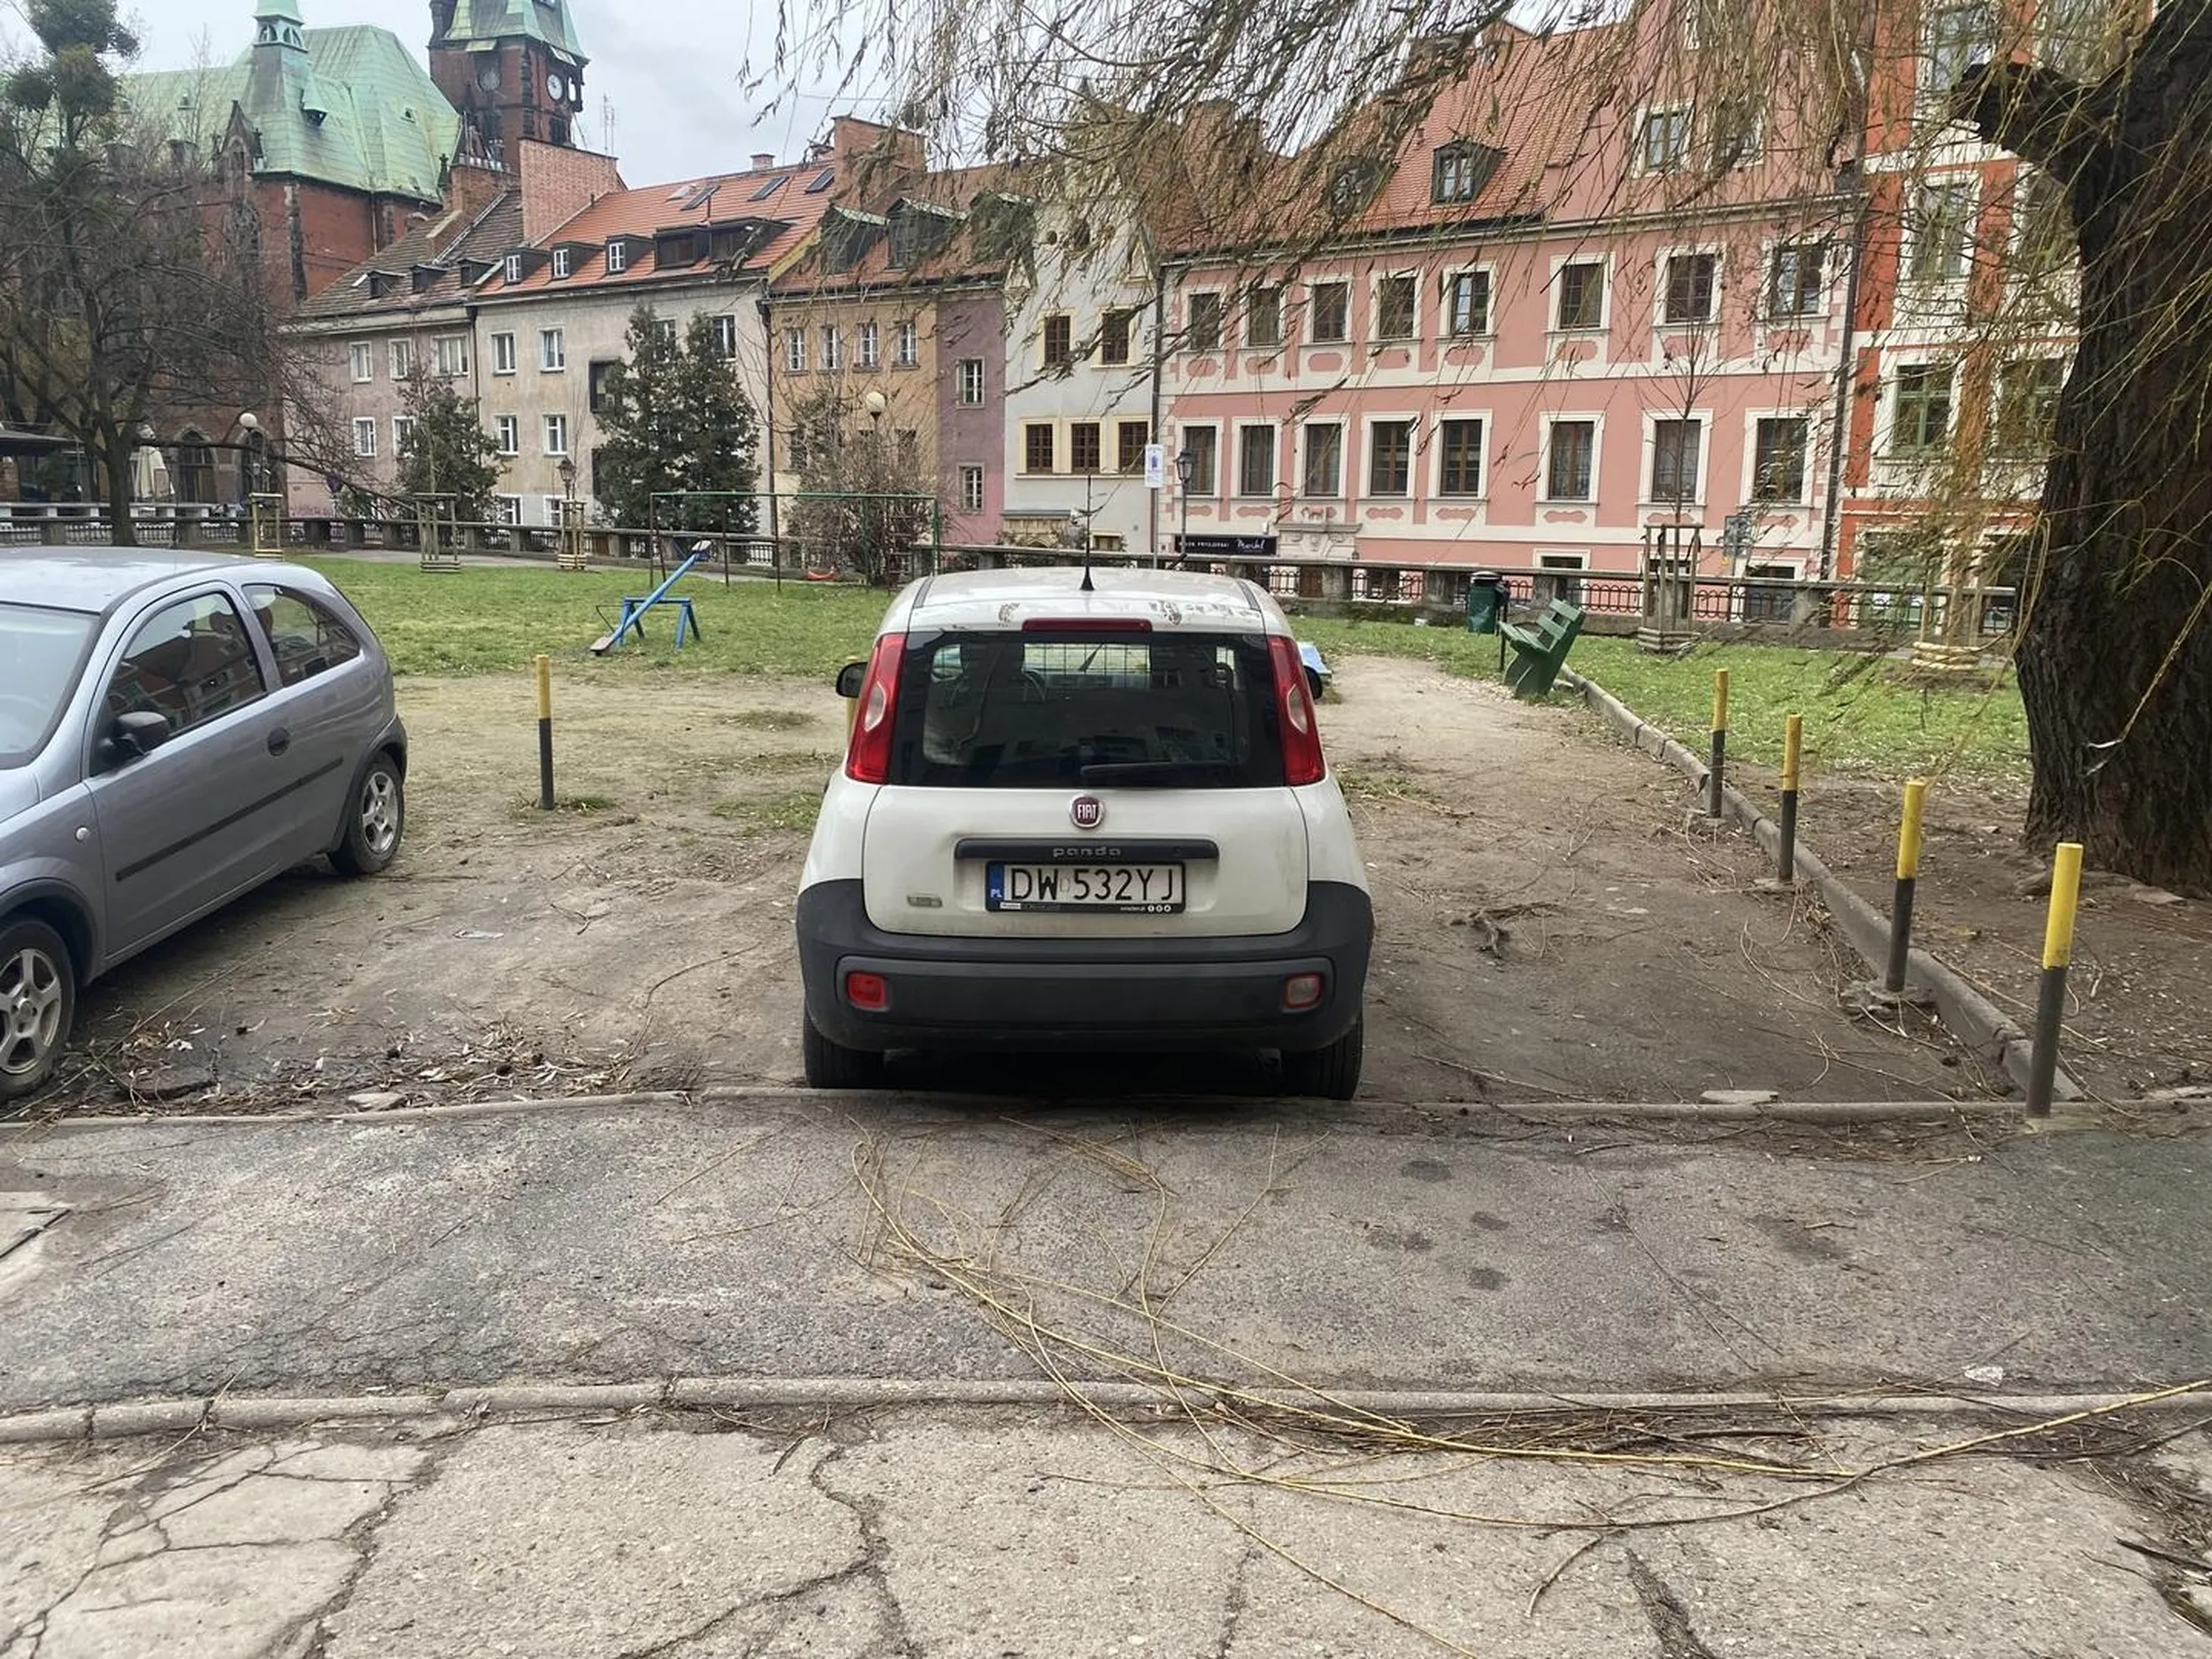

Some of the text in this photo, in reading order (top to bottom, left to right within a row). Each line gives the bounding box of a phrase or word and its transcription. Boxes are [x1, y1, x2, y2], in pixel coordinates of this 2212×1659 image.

[1077, 803, 1097, 820] FIAT
[1053, 846, 1121, 857] panda
[1010, 868, 1173, 901] DW 532YJ
[990, 888, 1002, 898] PL
